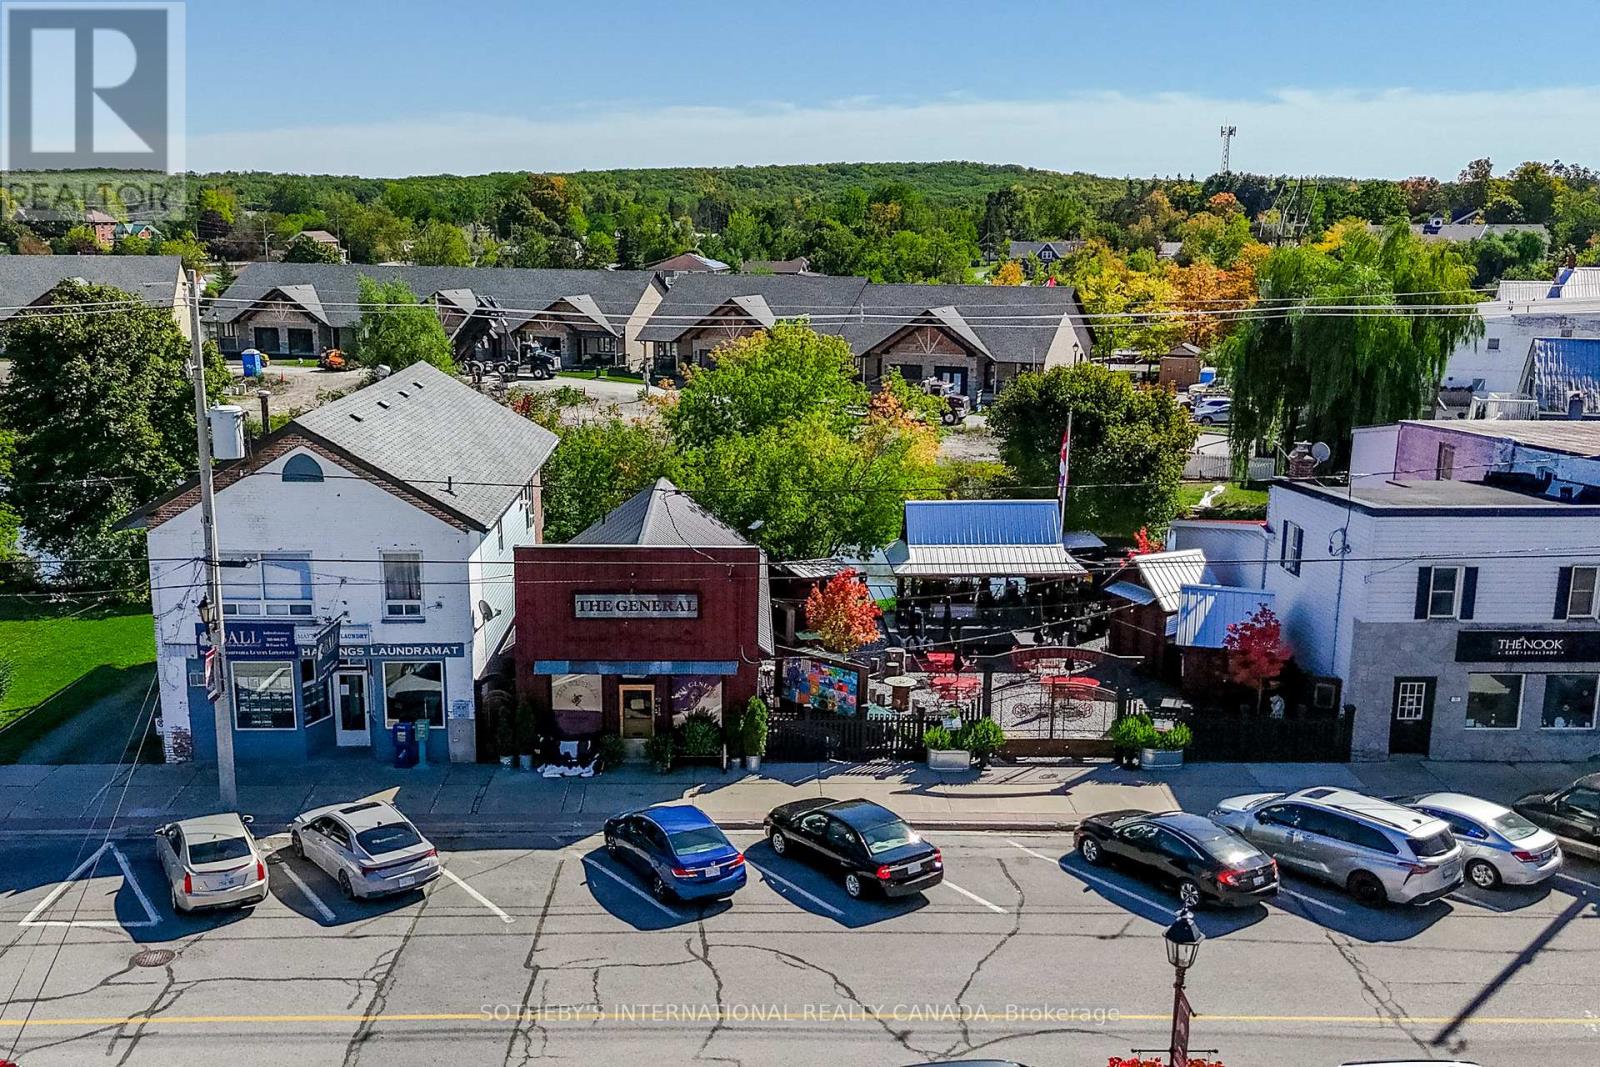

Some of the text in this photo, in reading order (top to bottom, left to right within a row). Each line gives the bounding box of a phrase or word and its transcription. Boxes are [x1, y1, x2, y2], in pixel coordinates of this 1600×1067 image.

[576, 600, 697, 612] THE GENERAL
[225, 631, 261, 644] ALL
[1498, 639, 1563, 649] THE NOOK
[302, 647, 459, 656] HANGS LAUNDRAMAT
